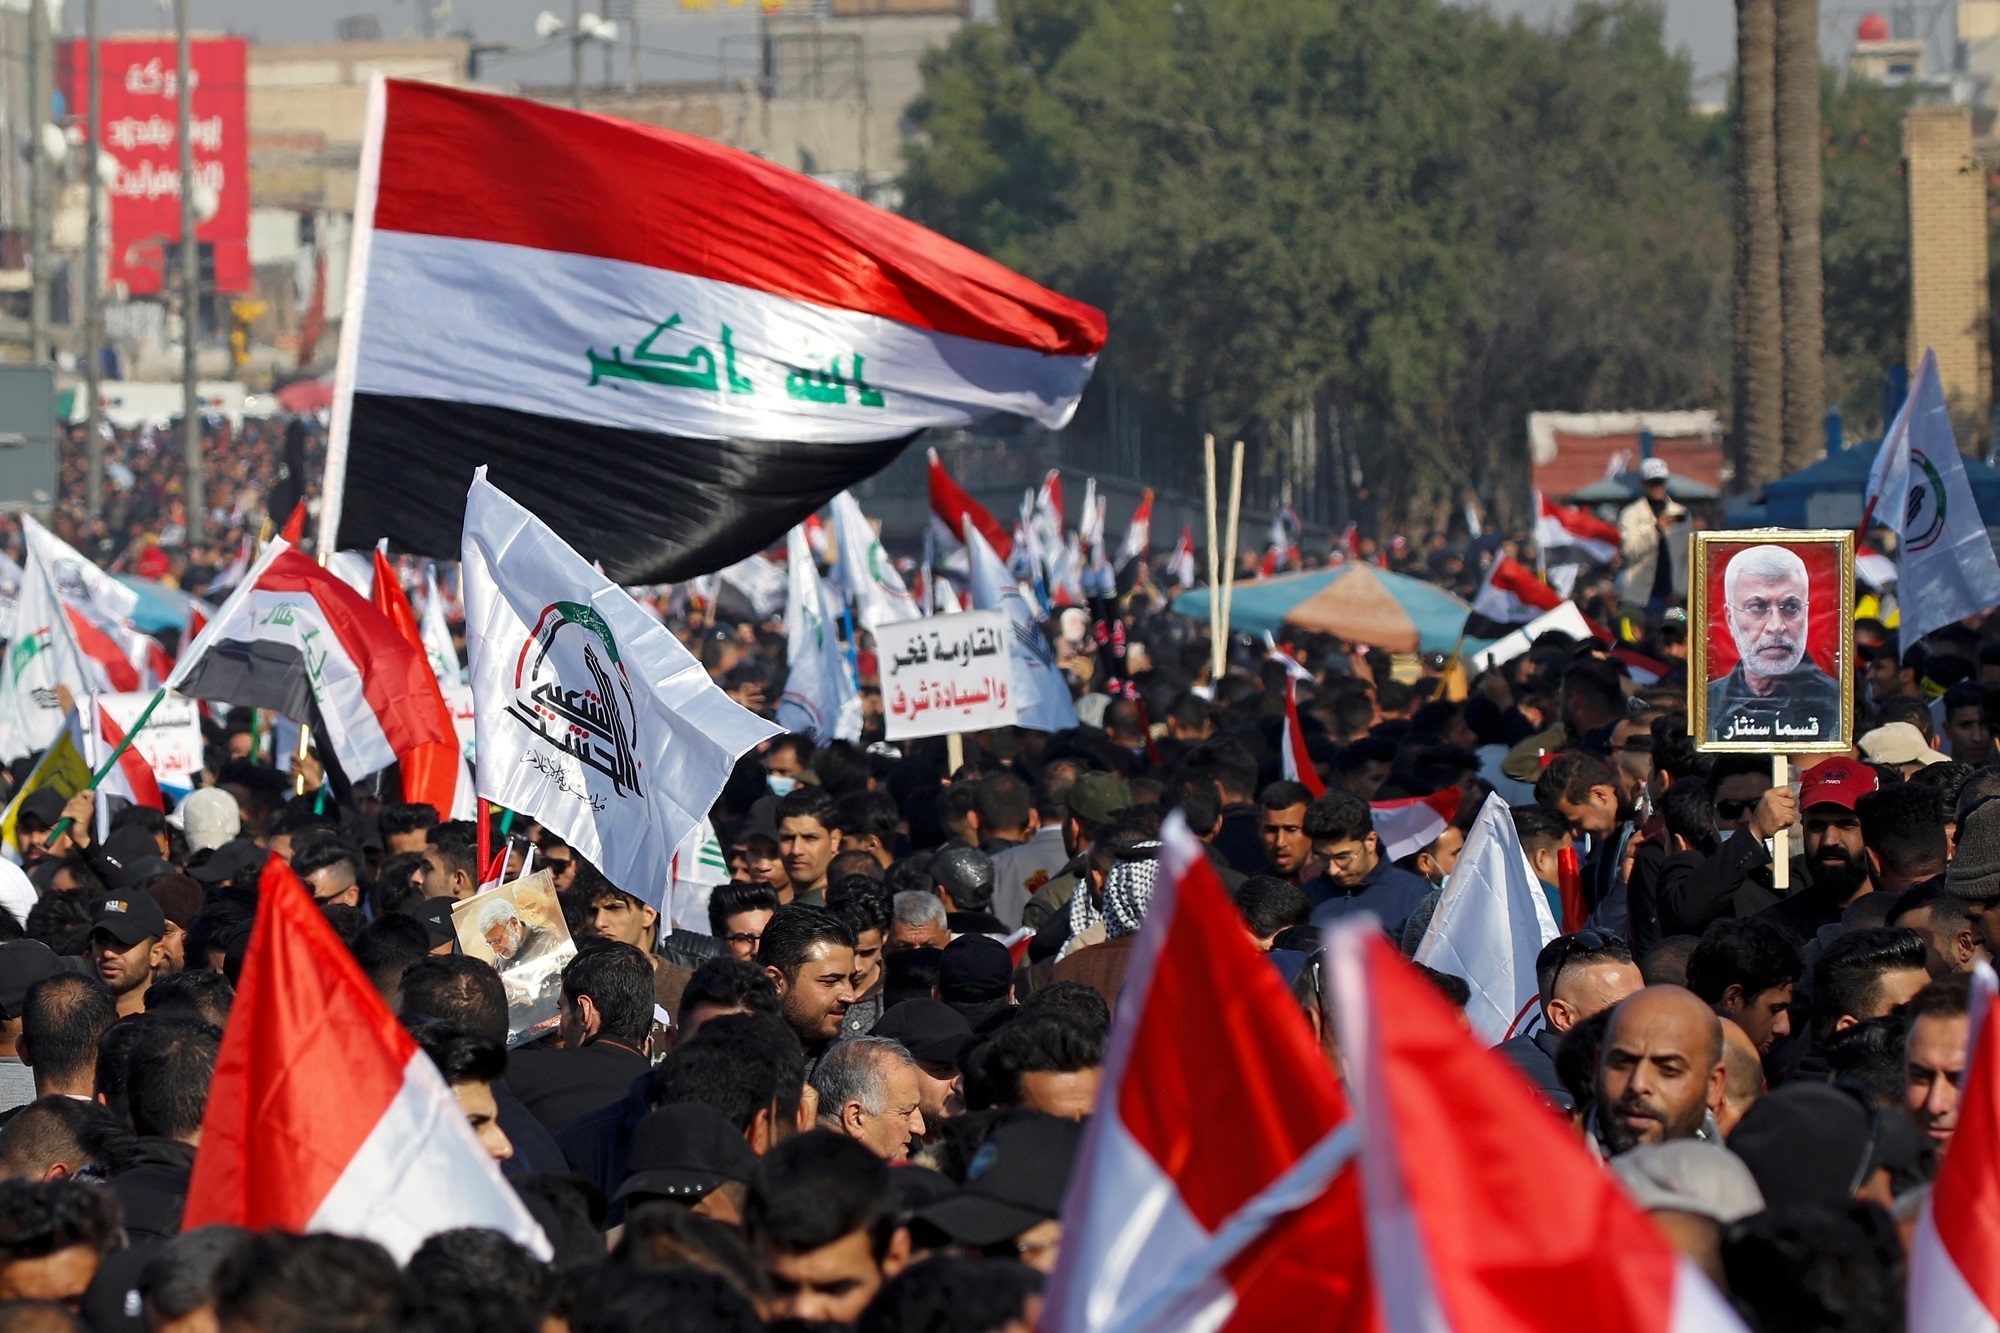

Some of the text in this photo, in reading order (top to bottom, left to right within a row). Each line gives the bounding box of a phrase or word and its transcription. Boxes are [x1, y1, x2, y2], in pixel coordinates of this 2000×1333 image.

[889, 634, 929, 676] فخر
[930, 626, 1004, 667] المقاومة
[891, 676, 1008, 721] والسيادة شرف
